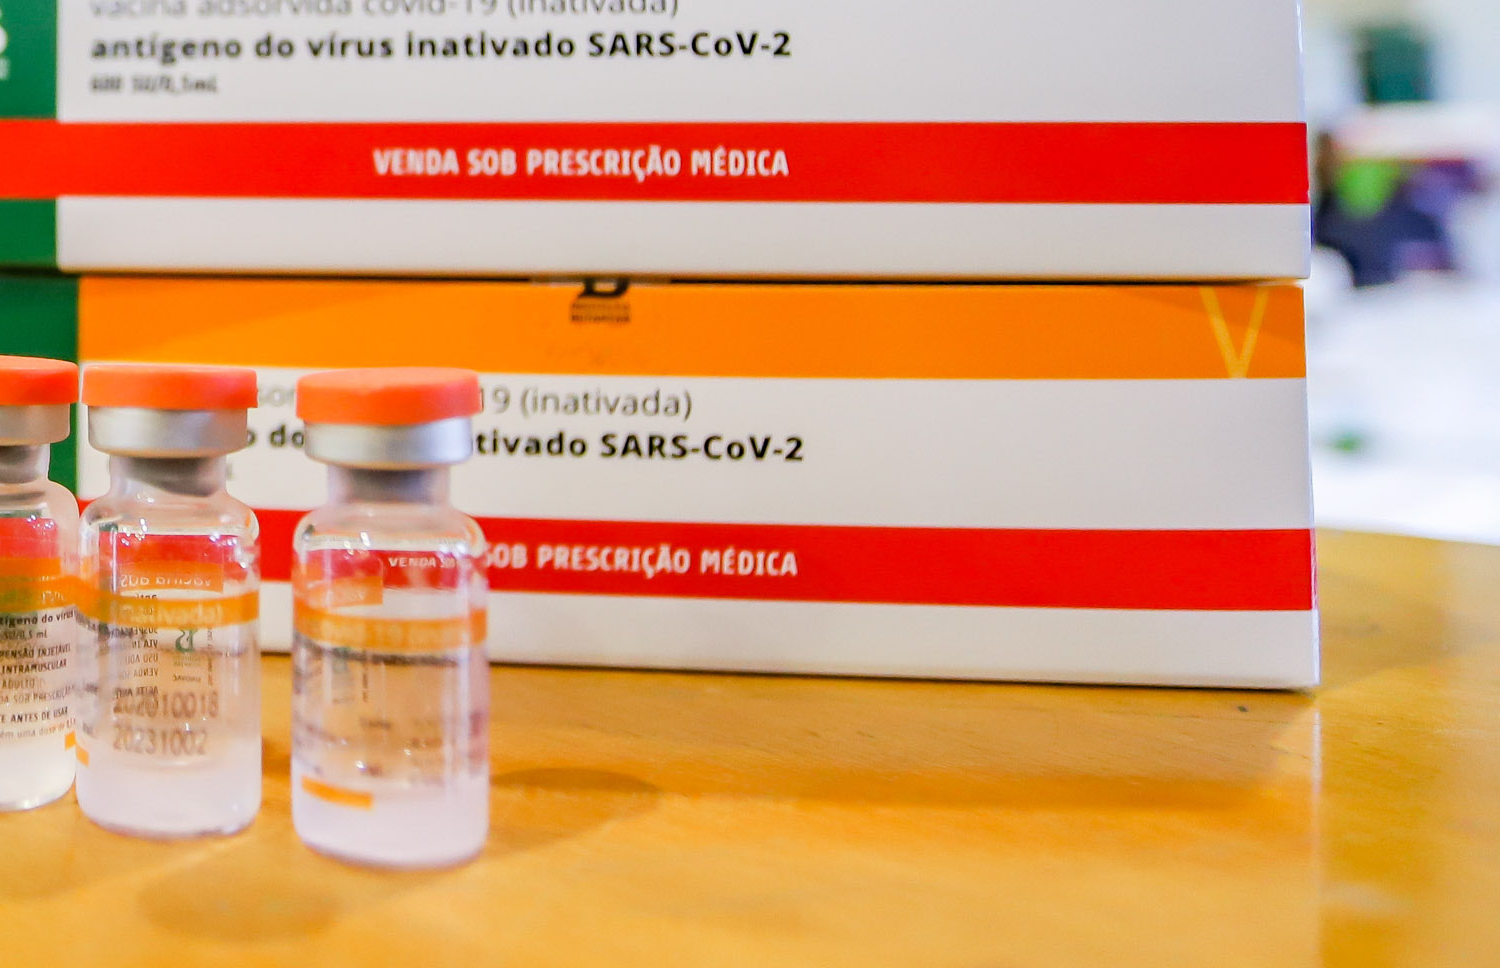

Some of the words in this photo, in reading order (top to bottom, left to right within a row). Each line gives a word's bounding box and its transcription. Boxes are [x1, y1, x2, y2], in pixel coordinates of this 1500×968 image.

[91, 32, 243, 66] antígeno
[254, 32, 294, 58] do
[307, 31, 394, 58] vírus
[405, 31, 576, 58] inativado
[588, 31, 792, 58] SARS-CoV-2
[372, 148, 460, 177] VENDA
[467, 148, 518, 177] SOB
[526, 144, 682, 184] PRESCRIÇÃO
[691, 144, 790, 178] MÉDICA
[520, 386, 693, 422] (inativada)
[475, 429, 587, 458] tivado
[600, 432, 804, 462] SARS-CoV-2
[537, 542, 691, 579] PRESCRIÇÃO
[700, 545, 798, 578] MÉDICA
[41, 614, 53, 624] do
[2, 659, 67, 675] INTRAMUSCULAR
[2, 678, 35, 690] ADULTO
[11, 713, 38, 723] ANTES
[41, 711, 51, 720] DE
